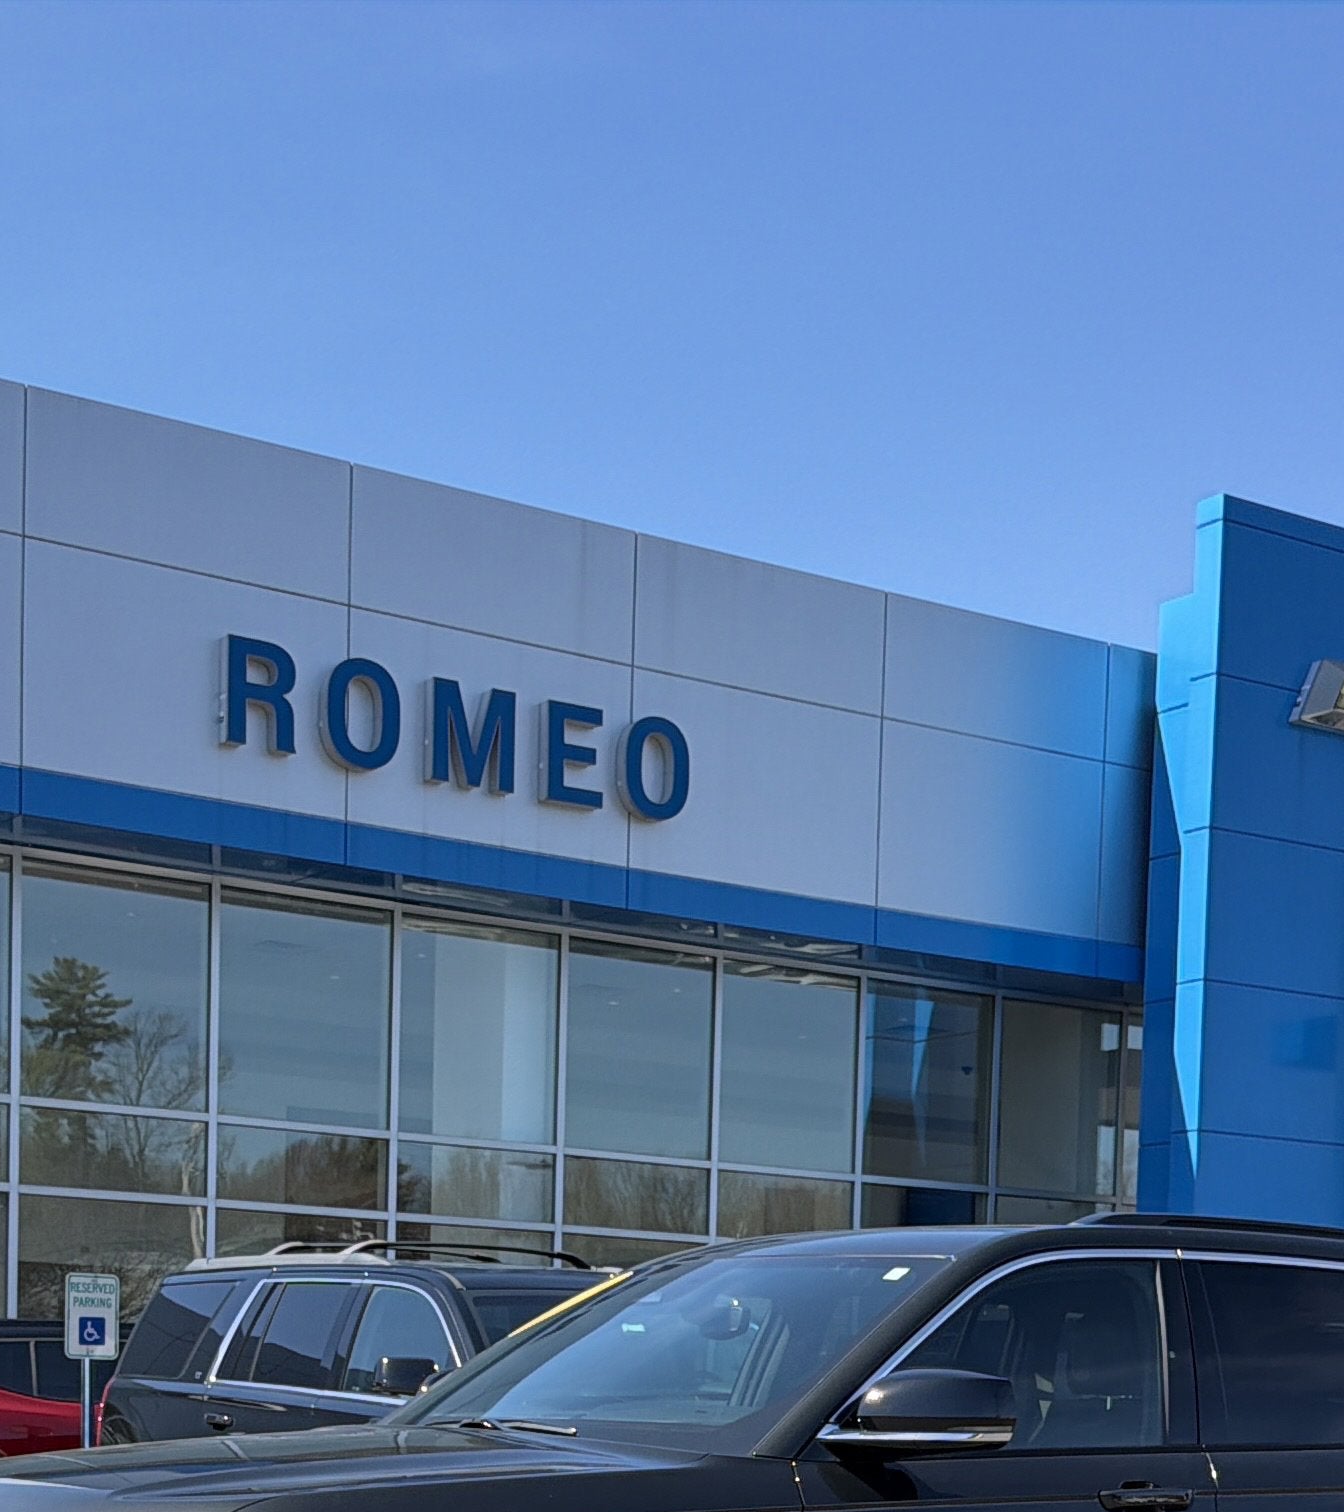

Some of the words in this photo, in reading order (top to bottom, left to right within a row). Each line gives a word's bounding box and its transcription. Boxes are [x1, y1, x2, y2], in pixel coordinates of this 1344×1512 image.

[219, 634, 690, 823] ROMEO
[70, 1282, 116, 1295] RESERVED
[73, 1296, 112, 1309] PARKING
